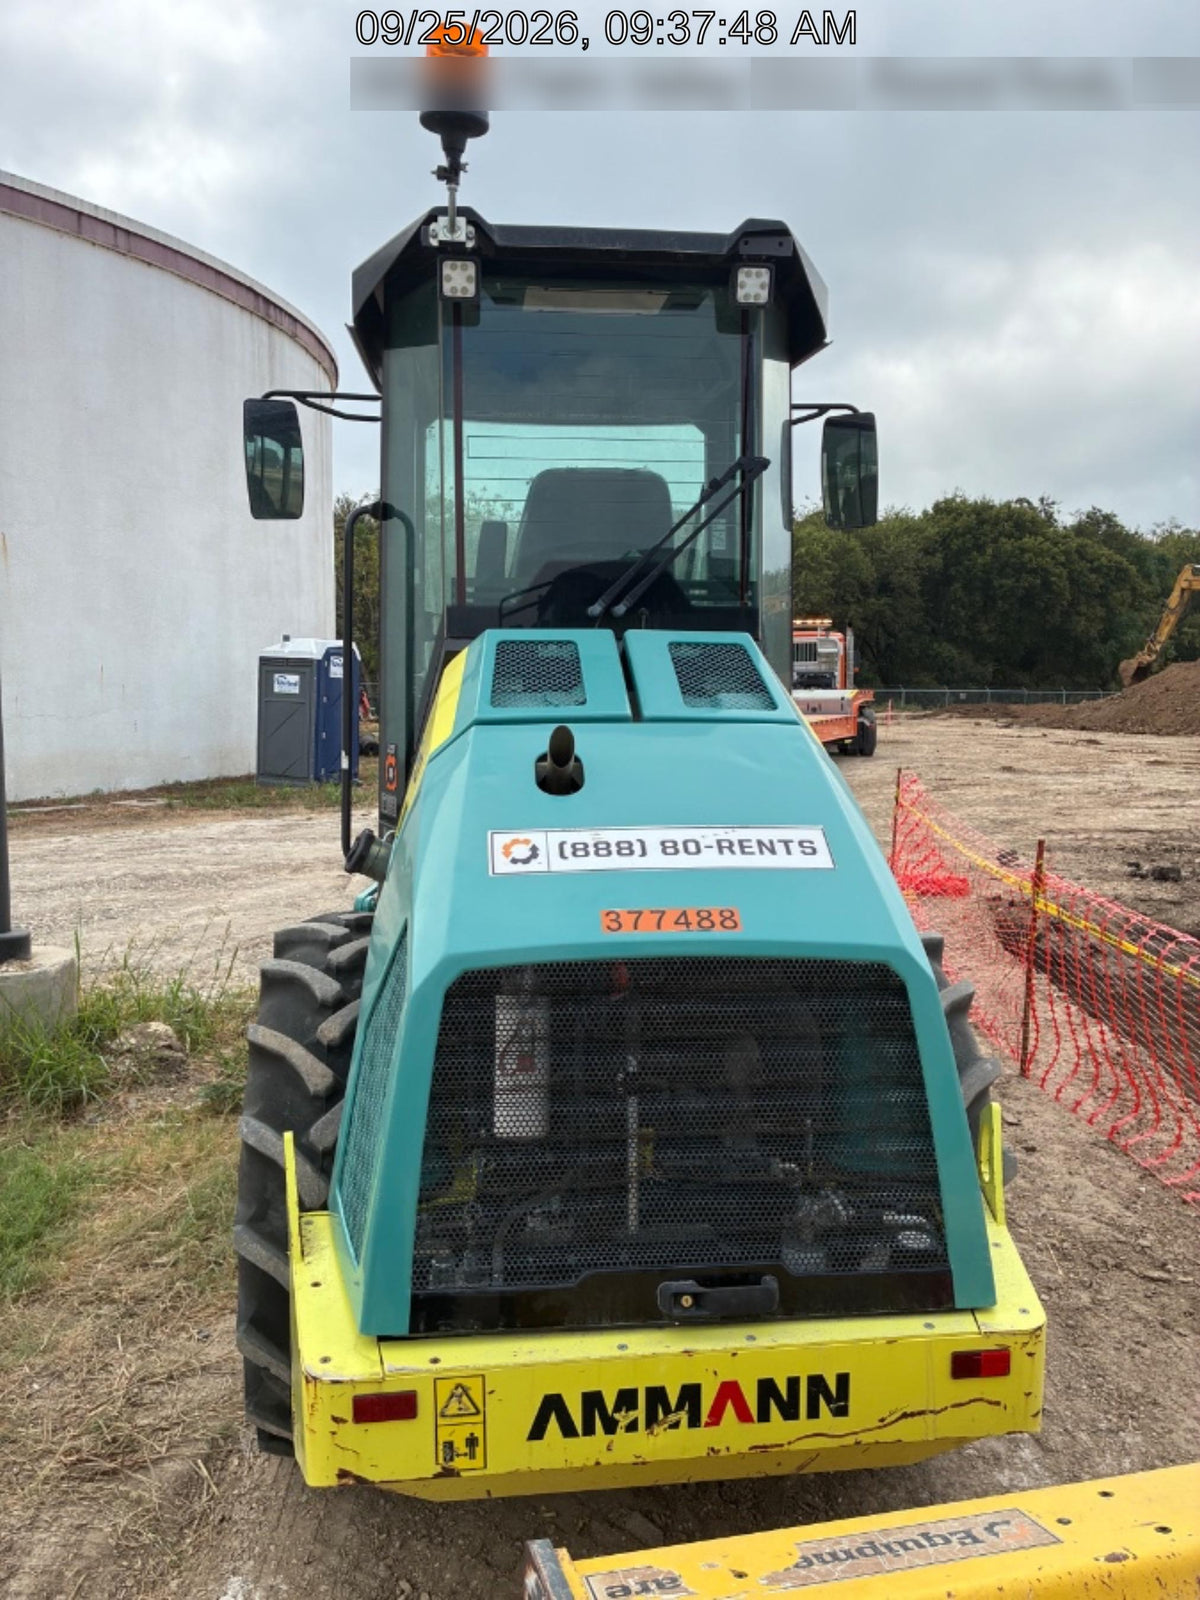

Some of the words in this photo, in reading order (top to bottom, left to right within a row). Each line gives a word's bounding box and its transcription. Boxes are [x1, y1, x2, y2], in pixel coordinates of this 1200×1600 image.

[557, 838, 648, 860] (888)
[659, 837, 818, 857] 80-RENTS
[604, 908, 739, 932] 377488
[526, 1372, 850, 1441] AMMANN
